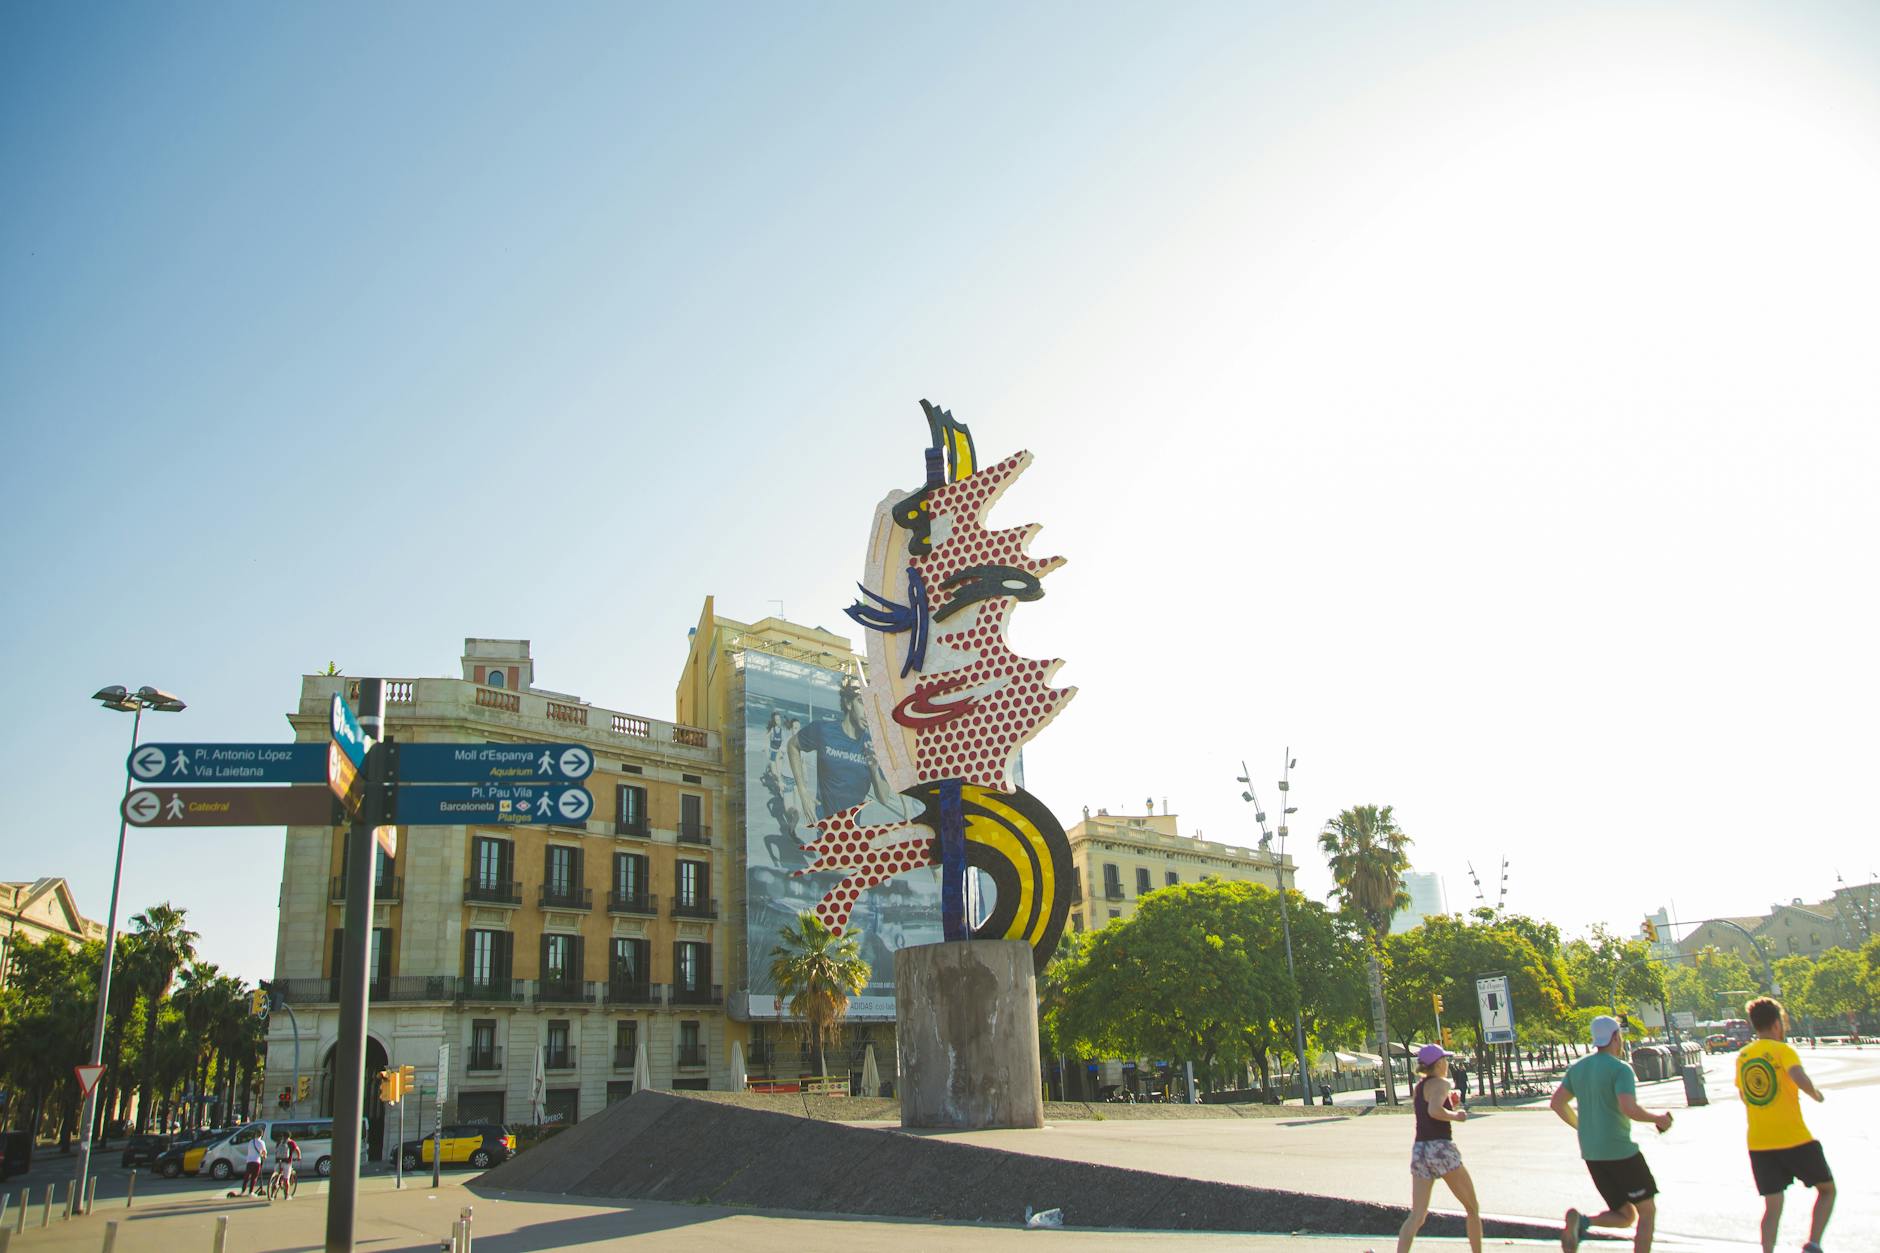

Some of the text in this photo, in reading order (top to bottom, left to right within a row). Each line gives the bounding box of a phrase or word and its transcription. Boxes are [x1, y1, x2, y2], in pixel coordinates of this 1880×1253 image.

[194, 748, 293, 762] Pl. Antonio López
[454, 749, 534, 763] Moll d'Espanya
[194, 764, 264, 777] Via Laietana
[471, 787, 533, 798] Pl. Pau Vila
[188, 801, 230, 812] Catedral
[439, 801, 495, 812] Barceloneta
[497, 813, 532, 823] Platges
[850, 1001, 873, 1010] ADIDAS
